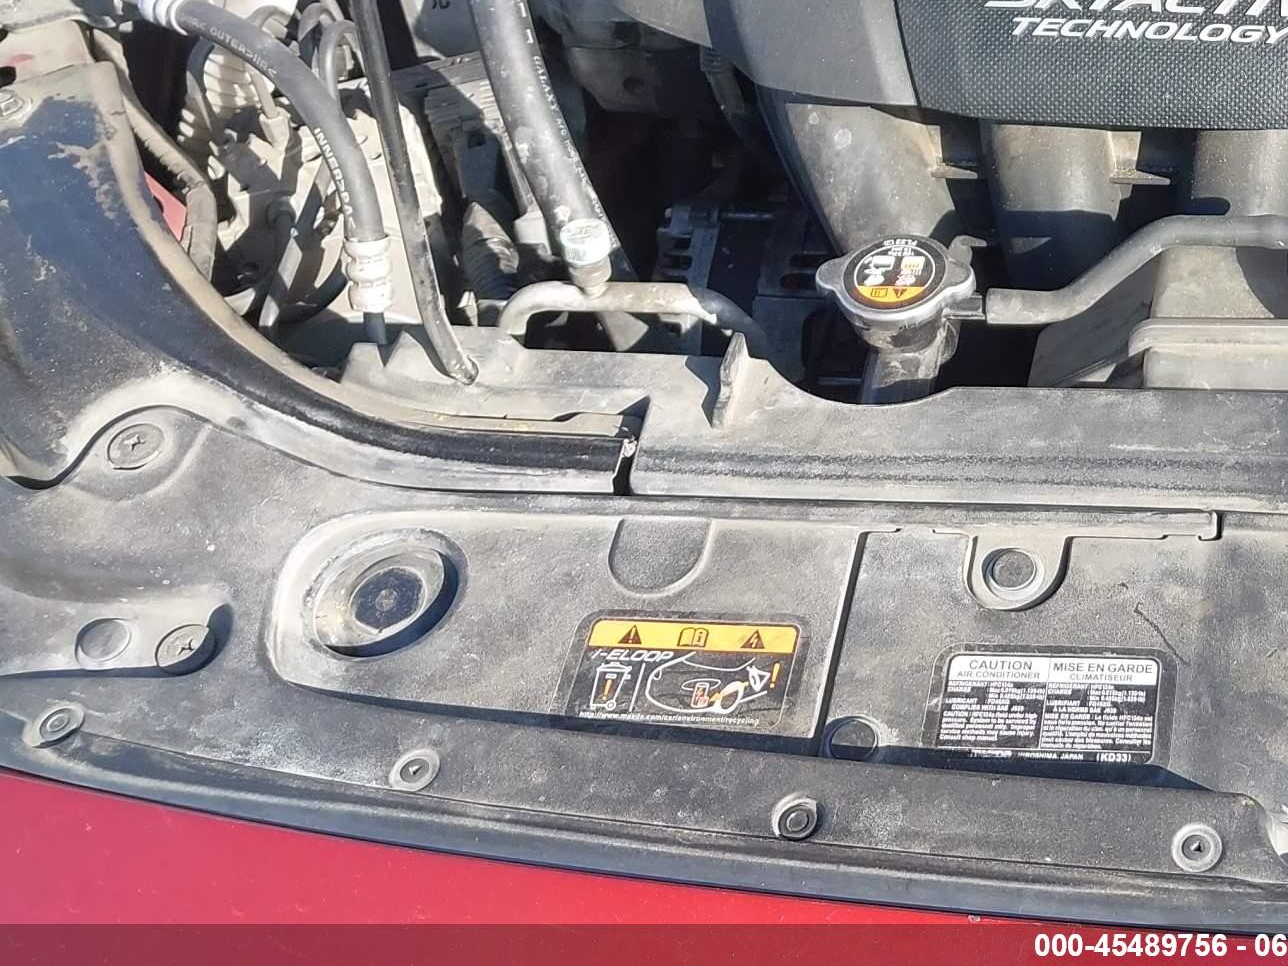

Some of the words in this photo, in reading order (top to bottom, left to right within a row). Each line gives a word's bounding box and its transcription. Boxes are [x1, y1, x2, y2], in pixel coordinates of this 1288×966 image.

[533, 56, 559, 111] GALAXY
[969, 660, 1033, 670] CAUTION
[1053, 662, 1084, 672] MISE
[1088, 663, 1105, 672] EN
[1108, 664, 1153, 674] GARDE
[957, 670, 973, 678] AIR
[975, 671, 1041, 679] CONDITIONER
[1069, 673, 1133, 681] CLIMATISEUR
[1096, 753, 1131, 762] (KD33)
